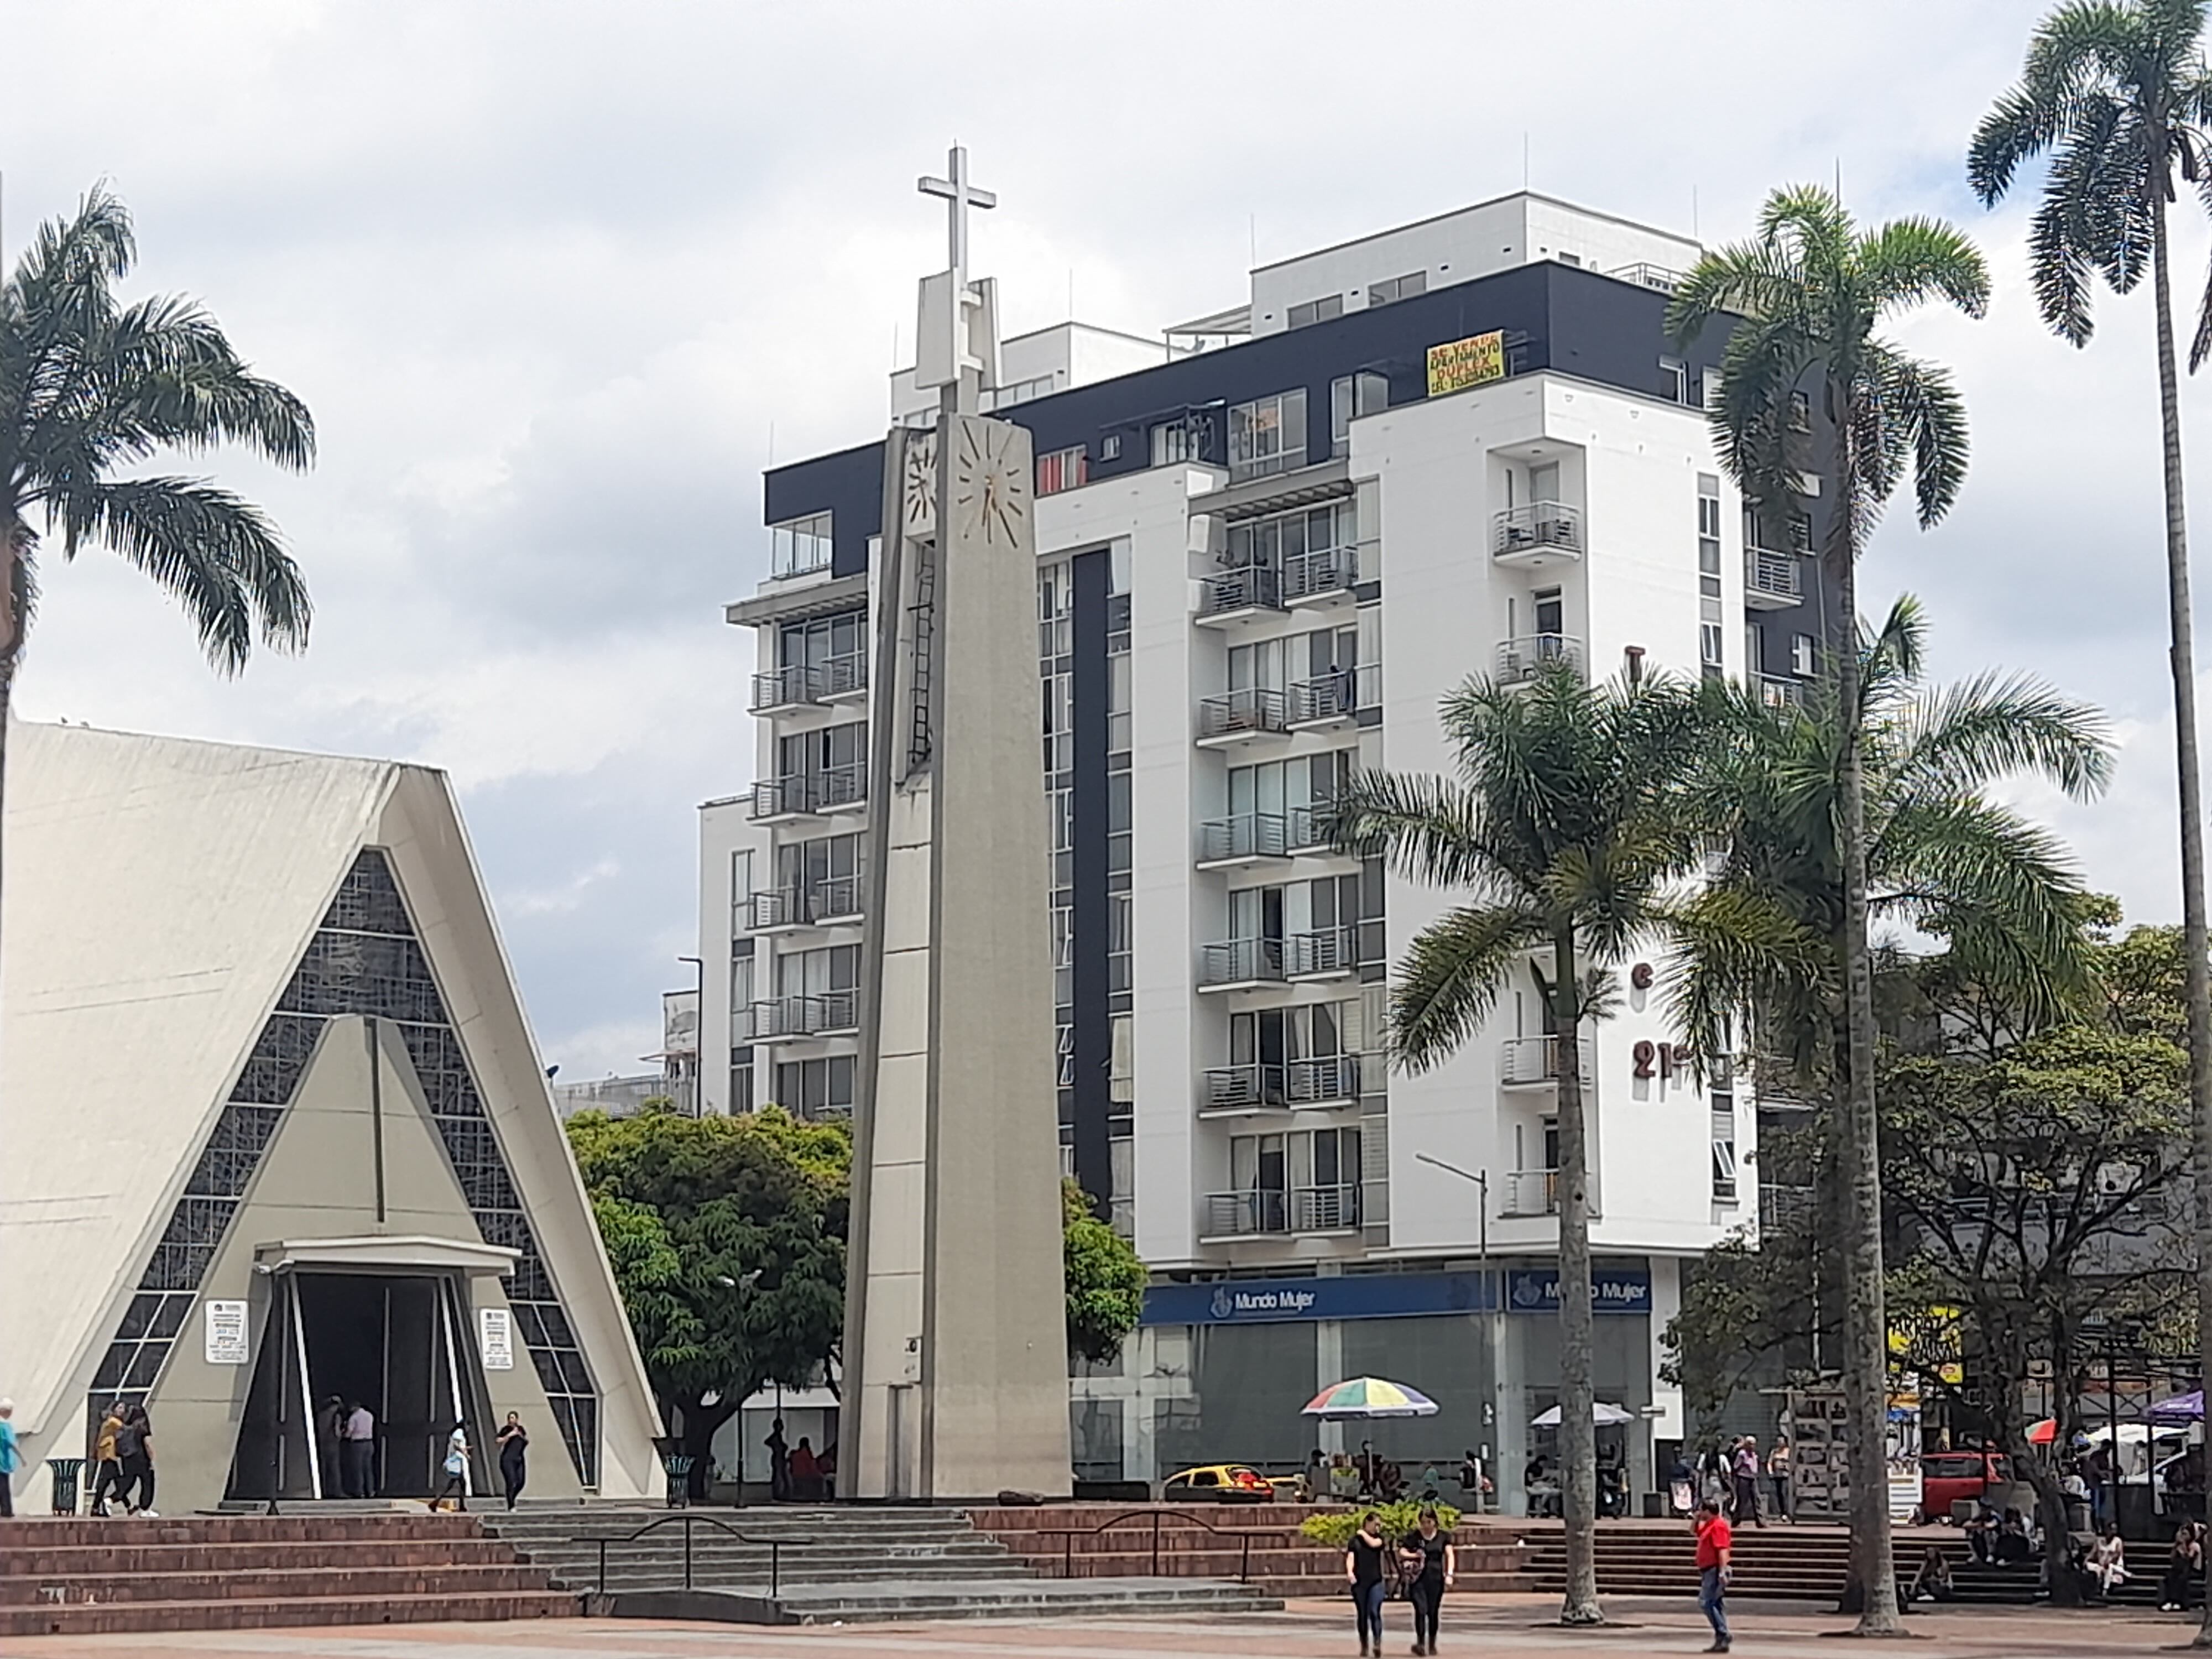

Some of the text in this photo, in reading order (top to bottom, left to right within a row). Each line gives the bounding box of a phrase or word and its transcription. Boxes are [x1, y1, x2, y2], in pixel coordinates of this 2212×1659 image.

[1431, 348, 1447, 359] SE
[1438, 357, 1490, 379] DUPLEX
[1235, 1291, 1315, 1311] Mundo Mujer
[1603, 1282, 1646, 1302] Mujer
